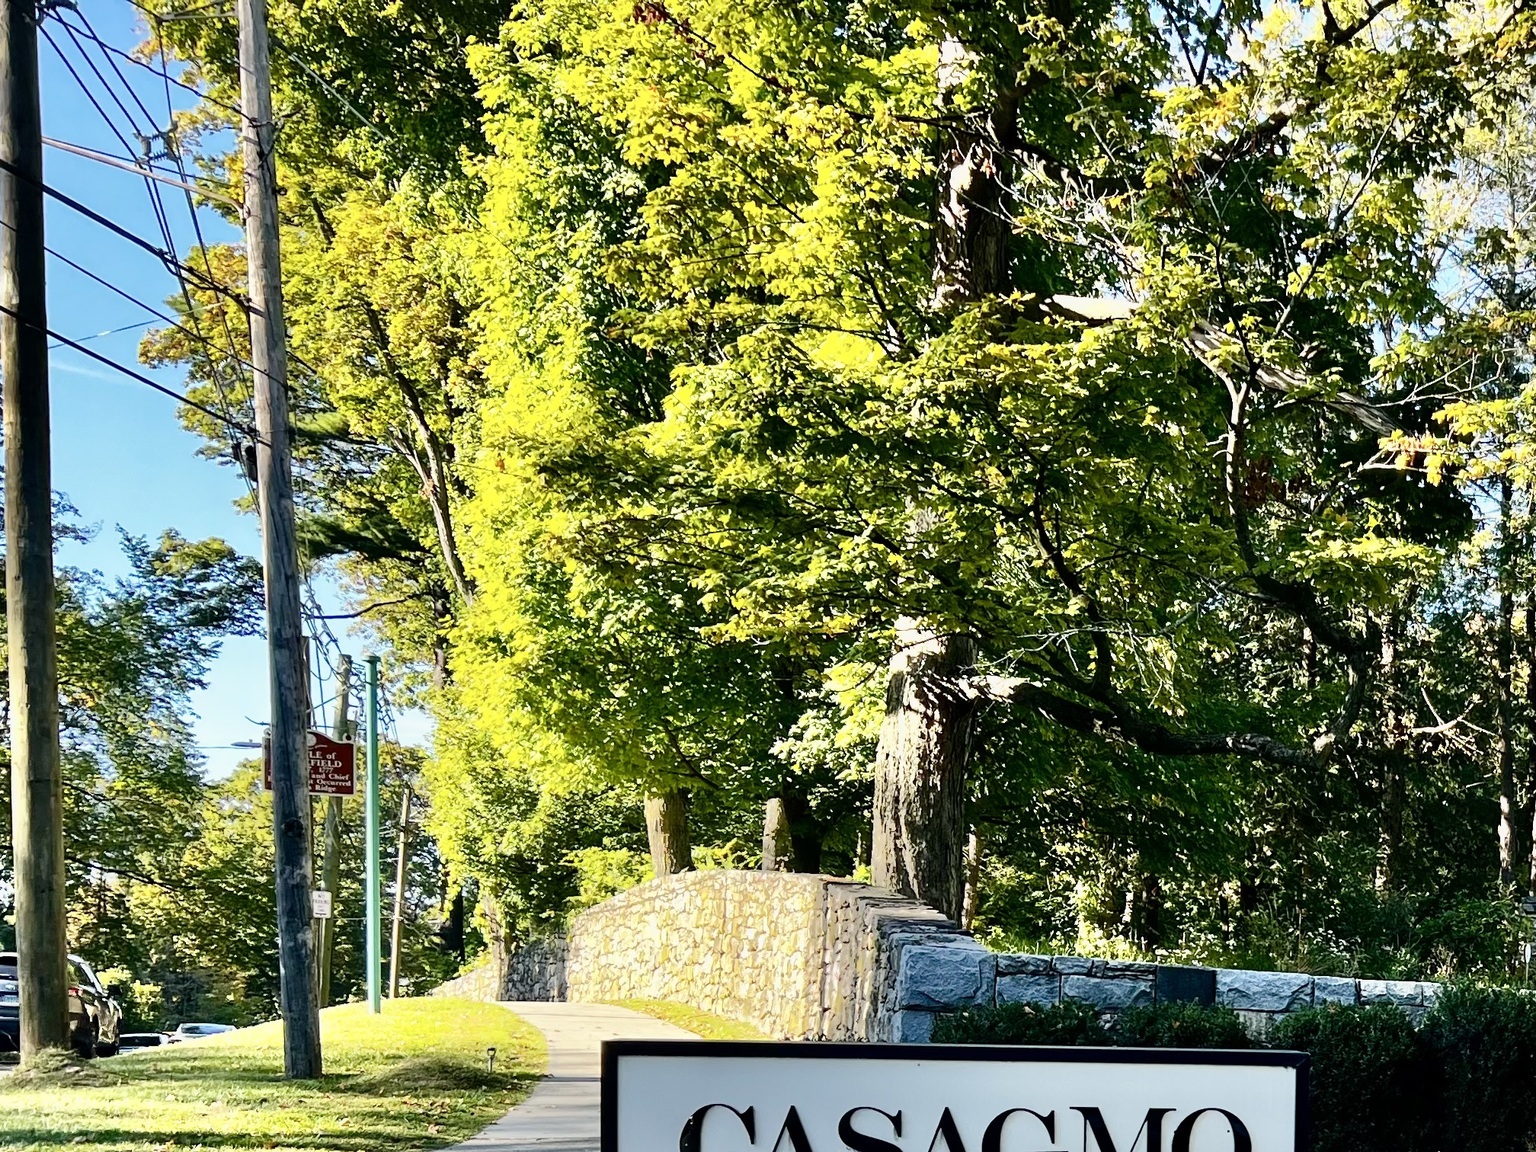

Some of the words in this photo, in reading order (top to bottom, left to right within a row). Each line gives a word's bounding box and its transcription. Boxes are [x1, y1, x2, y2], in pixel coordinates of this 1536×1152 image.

[327, 752, 337, 760] of
[329, 773, 350, 781] Chief
[317, 779, 351, 787] Occurred
[315, 785, 336, 793] Ridge
